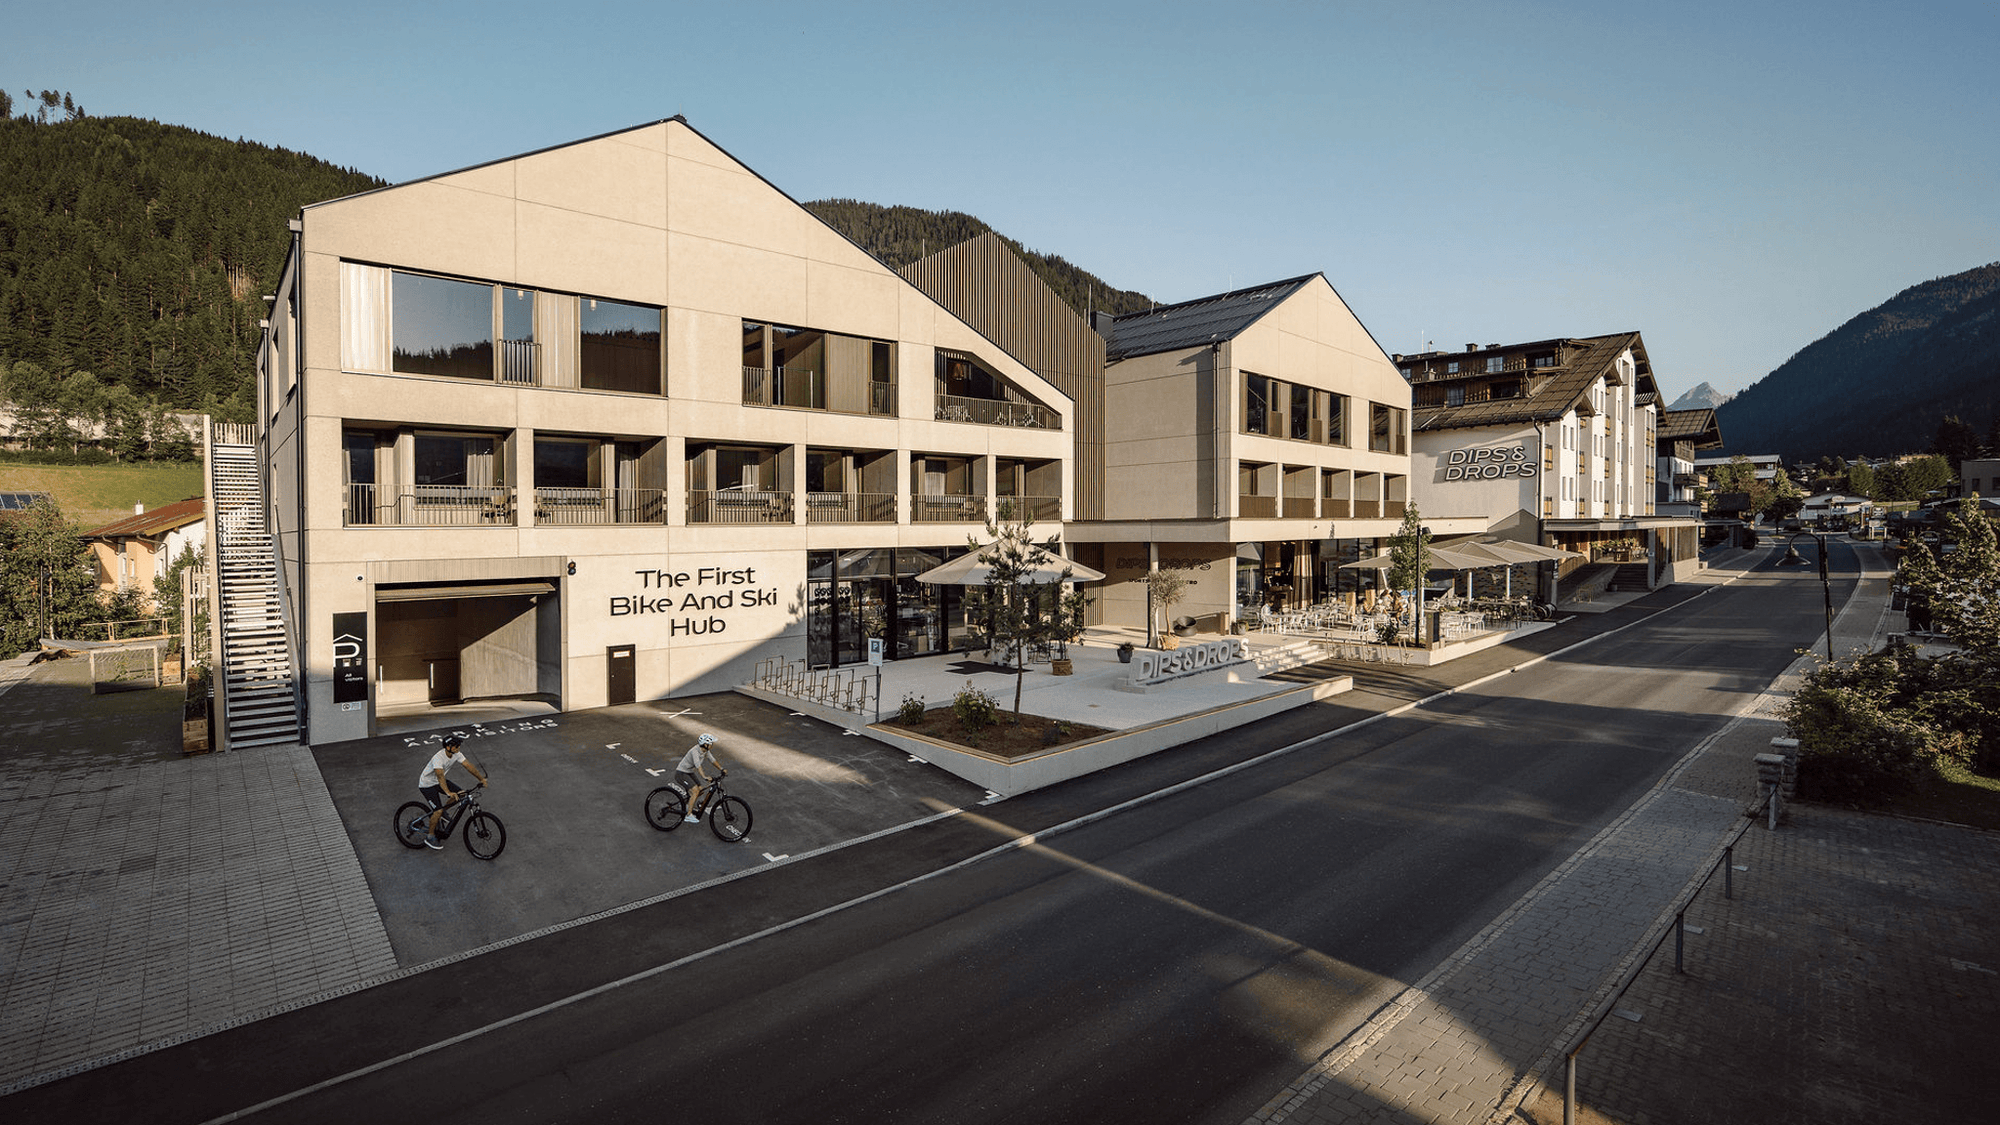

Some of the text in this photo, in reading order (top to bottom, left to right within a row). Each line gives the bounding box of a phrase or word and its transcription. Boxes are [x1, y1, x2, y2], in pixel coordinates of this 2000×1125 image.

[1445, 462, 1538, 481] DROPS
[635, 567, 756, 589] The First
[610, 588, 777, 616] Bike And Ski
[671, 615, 726, 637] Hub
